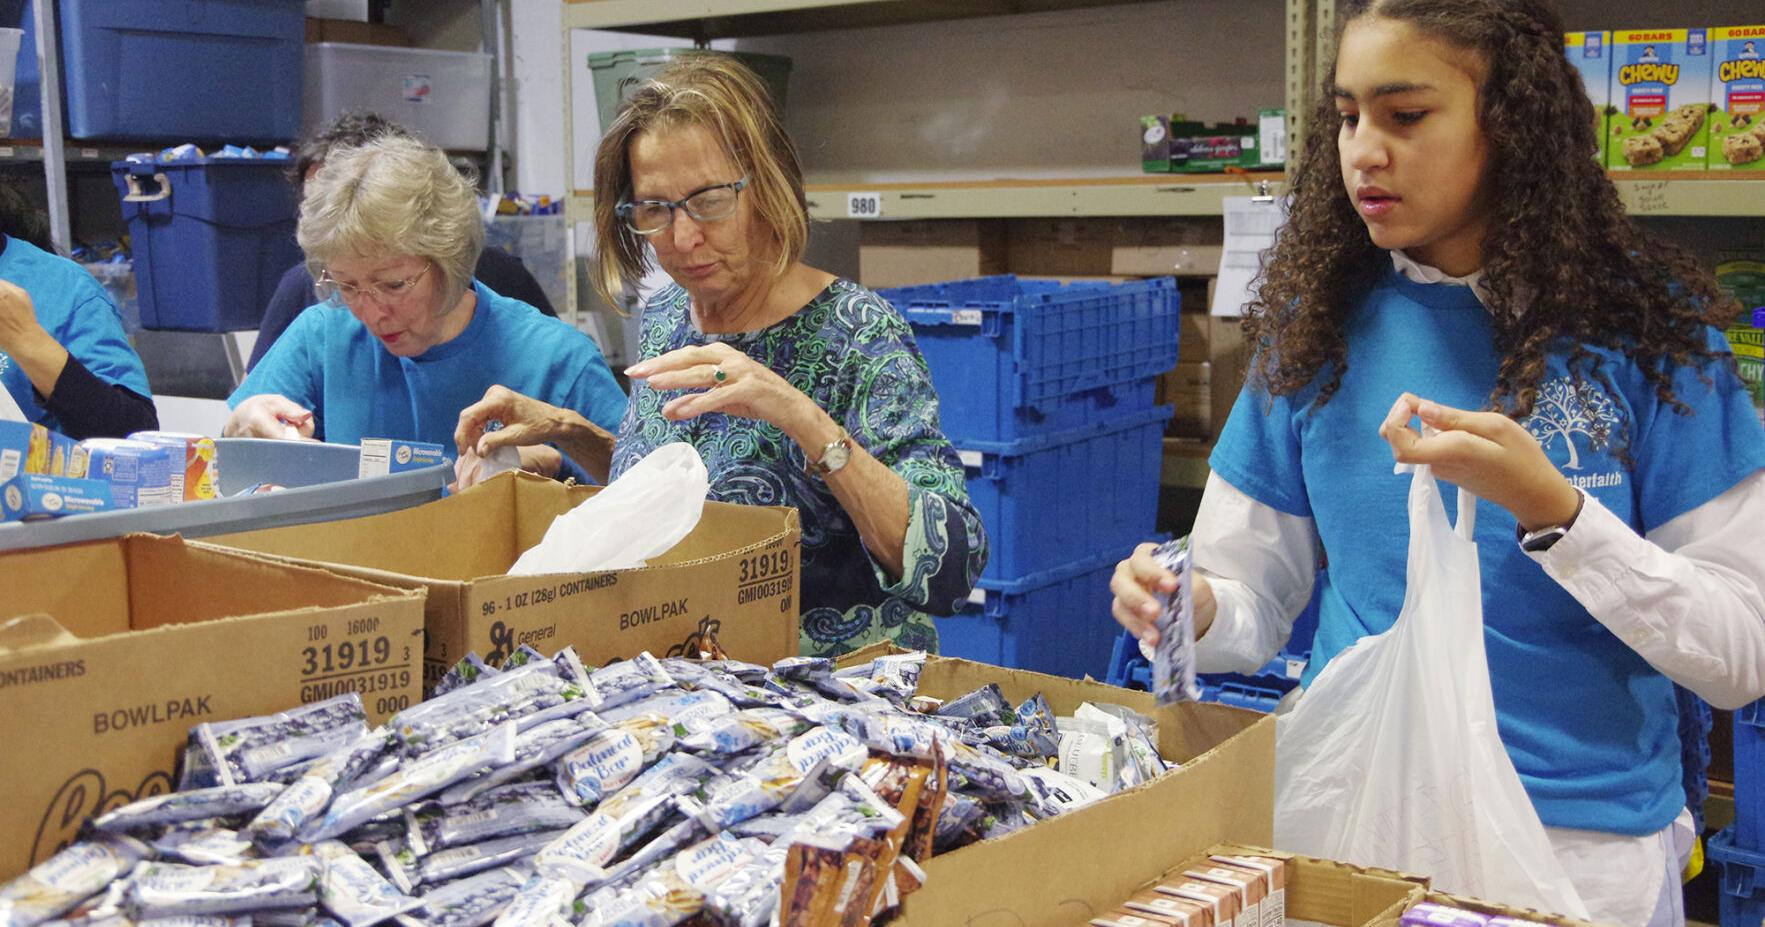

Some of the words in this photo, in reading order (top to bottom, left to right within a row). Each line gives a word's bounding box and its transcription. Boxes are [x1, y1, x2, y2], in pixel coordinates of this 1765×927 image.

[1643, 33, 1672, 41] BARS
[851, 198, 876, 214] 980
[1566, 471, 1622, 489] nterfaith
[739, 549, 788, 582] 31919
[482, 602, 495, 615] 96
[506, 597, 511, 610] 1
[515, 593, 528, 608] OZ
[531, 586, 556, 603] (28g)
[560, 573, 617, 597] CONTAINERS
[620, 598, 688, 631] BOWLPAK
[308, 624, 327, 642] 100
[347, 616, 379, 636] 16000
[518, 623, 556, 645] General
[302, 635, 390, 675] 31919
[93, 695, 212, 734] BOWLPAK
[376, 695, 409, 715] 000
